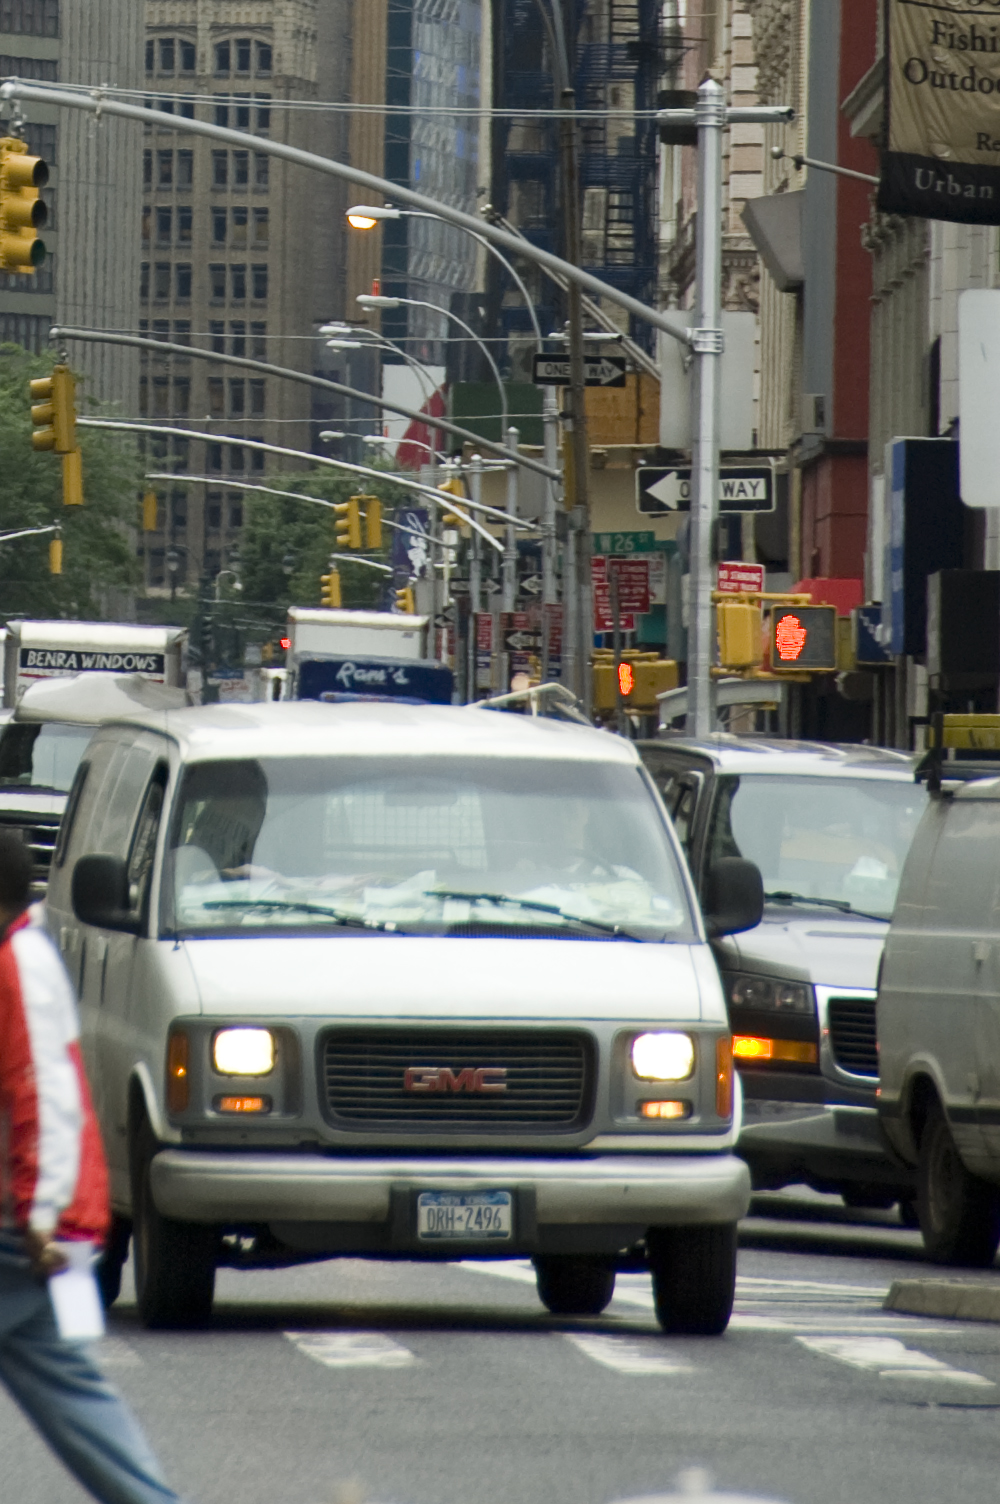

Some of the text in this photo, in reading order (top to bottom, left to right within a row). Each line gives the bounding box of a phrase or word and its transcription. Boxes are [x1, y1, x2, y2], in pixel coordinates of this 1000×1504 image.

[904, 57, 1000, 94] Outdo
[914, 167, 994, 199] Urban
[545, 363, 615, 378] ONE WAY
[722, 481, 761, 498] WAY
[614, 534, 635, 552] 26
[26, 650, 157, 672] BENRA WINDOWS
[403, 1067, 507, 1092] GMC
